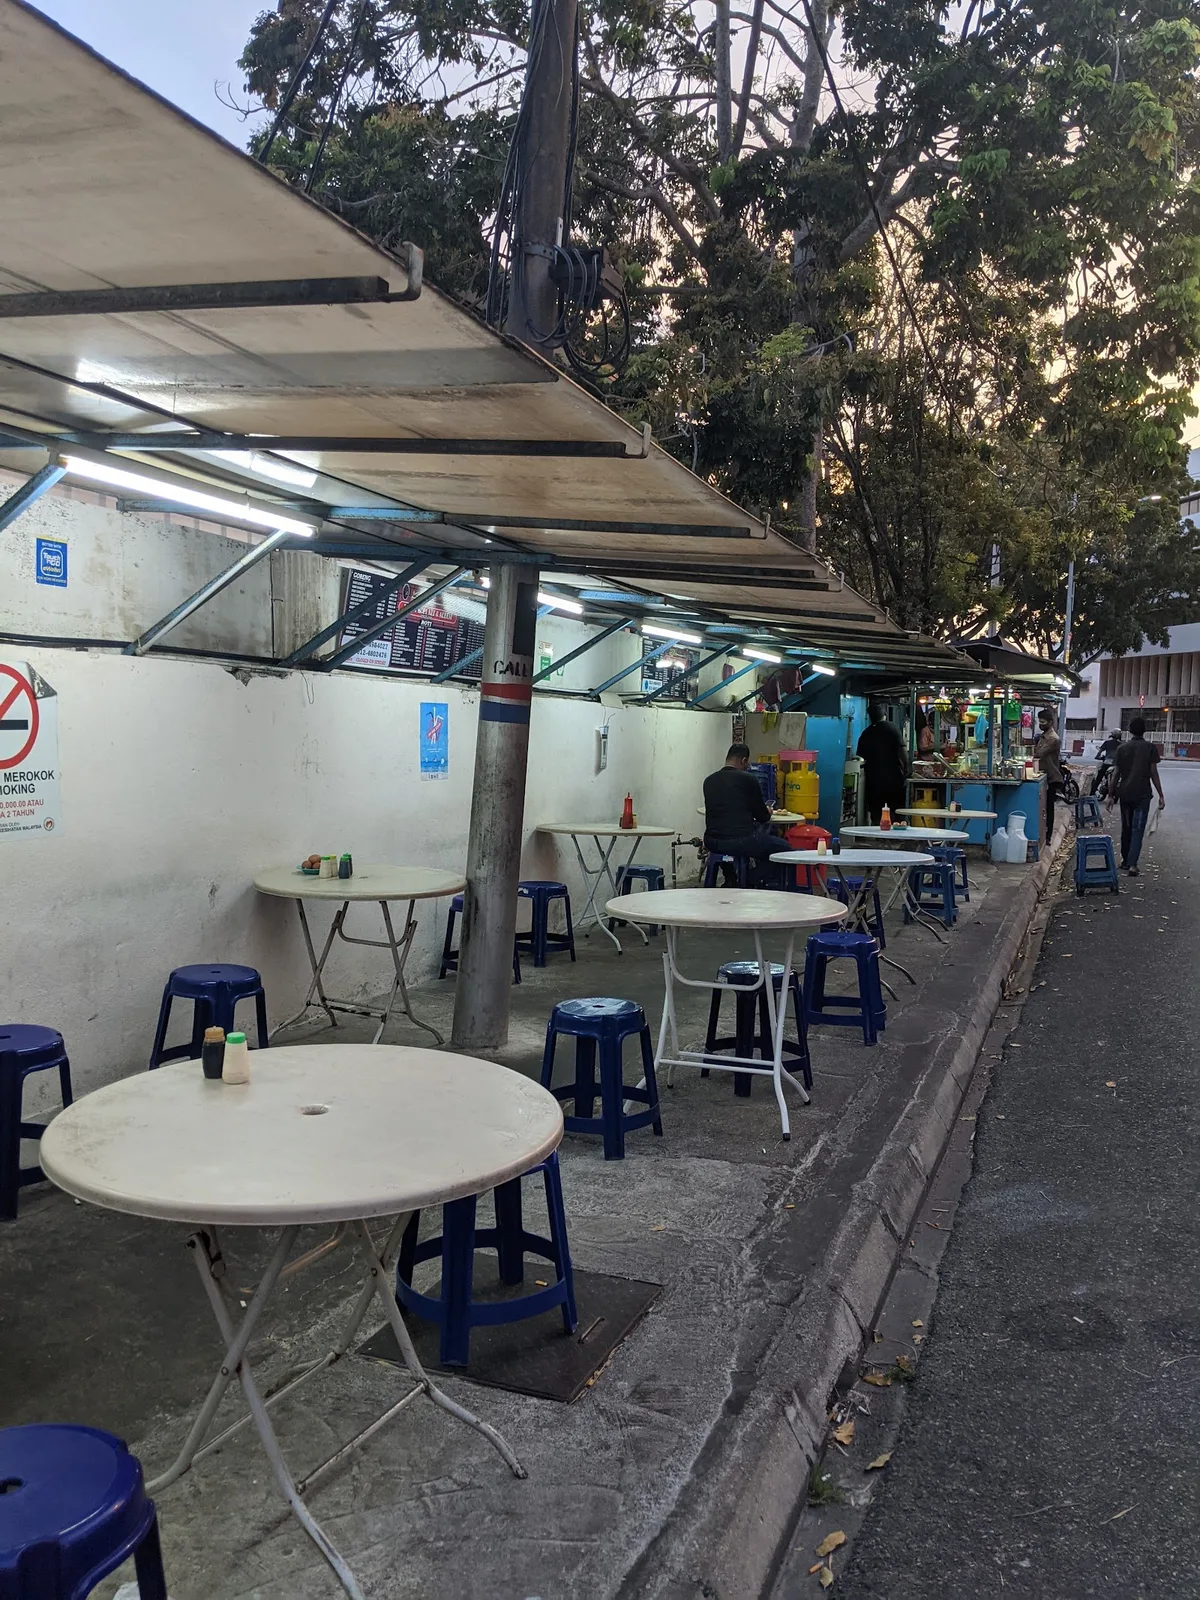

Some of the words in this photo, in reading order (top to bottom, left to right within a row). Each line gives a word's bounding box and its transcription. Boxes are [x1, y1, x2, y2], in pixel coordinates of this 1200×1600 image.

[43, 552, 61, 561] Touch
[4, 770, 55, 782] MEROKOK
[27, 799, 44, 807] ATAU
[13, 809, 35, 817] TAHUN
